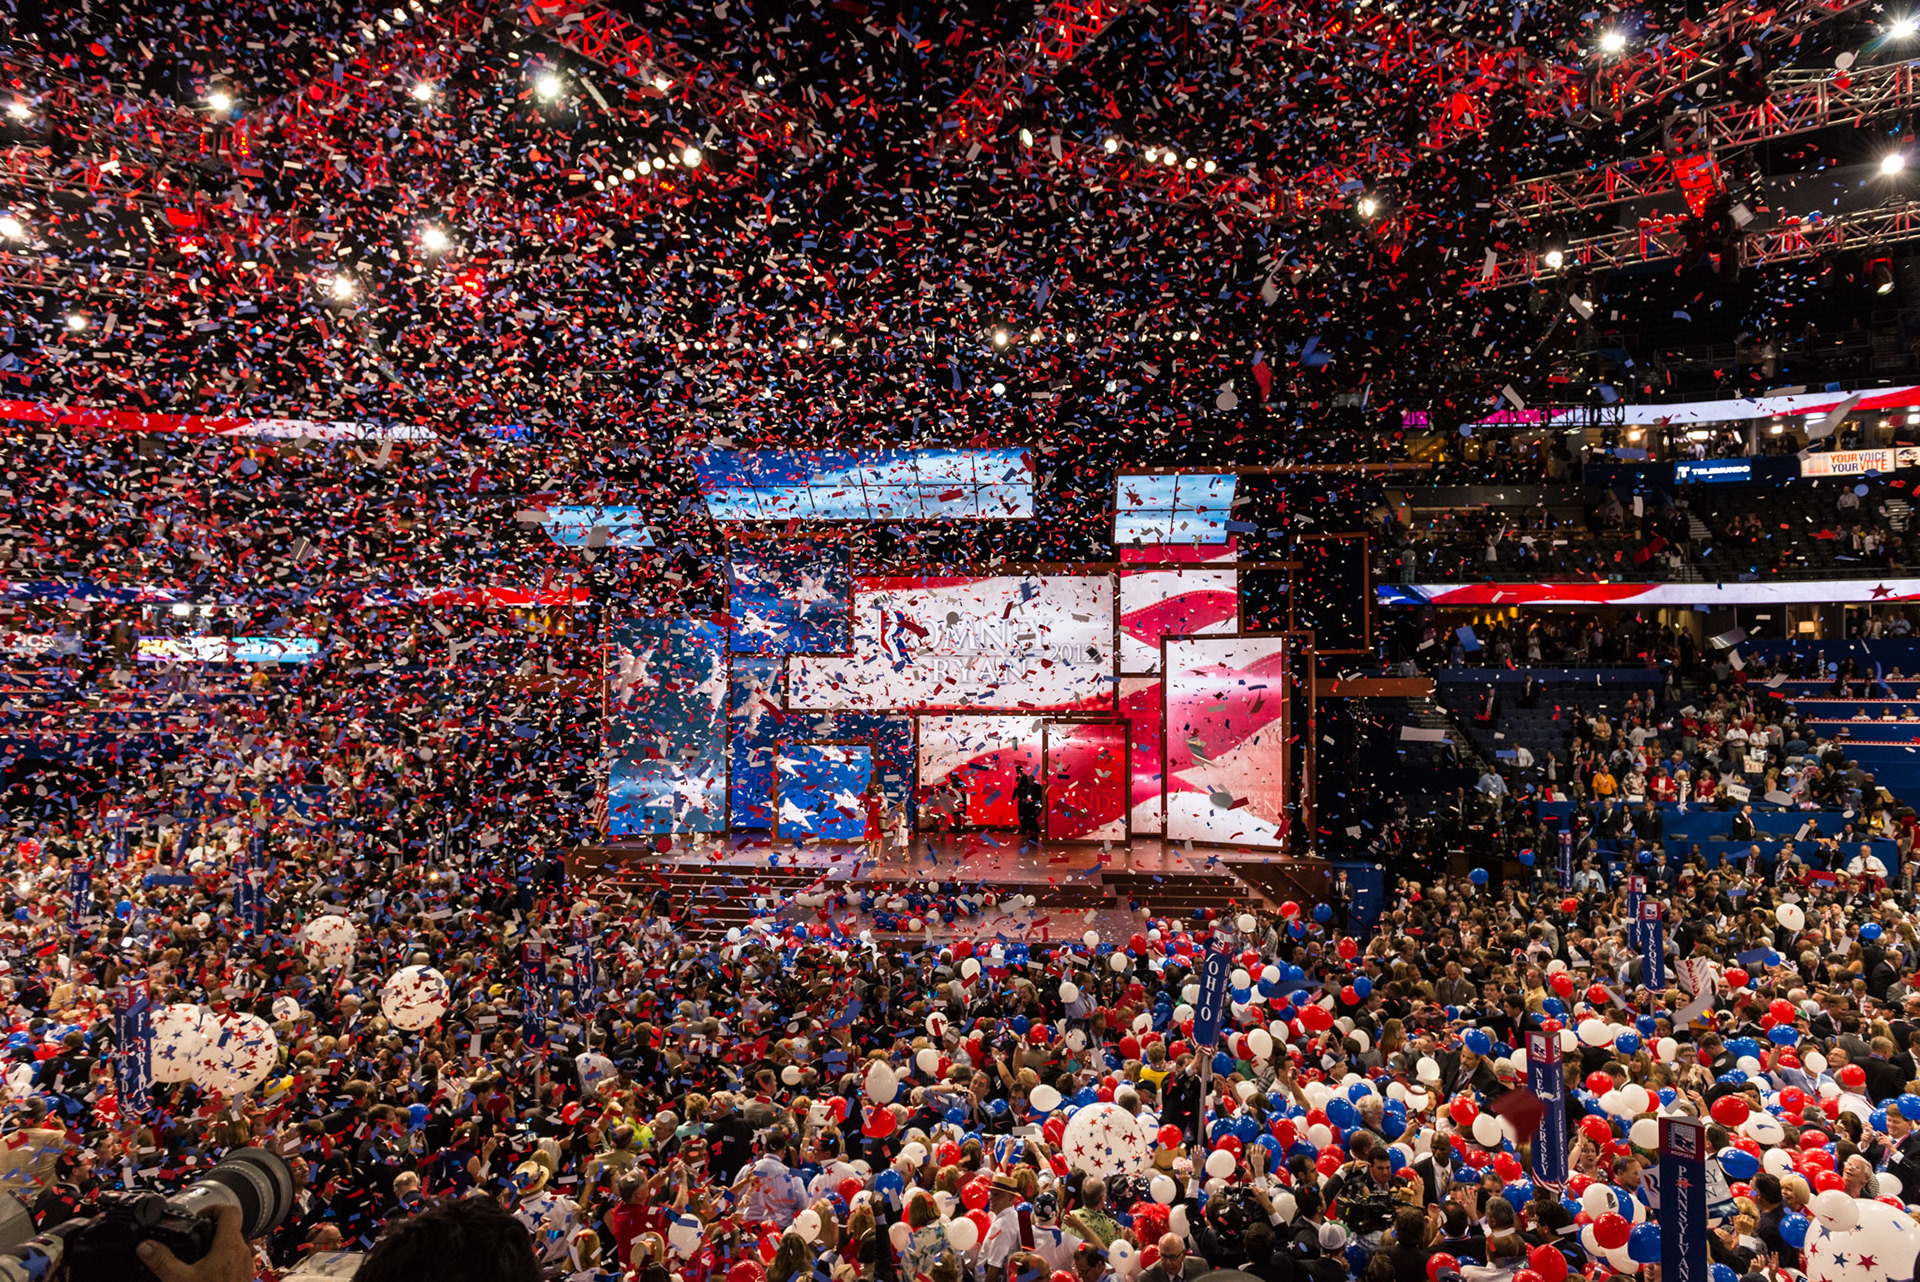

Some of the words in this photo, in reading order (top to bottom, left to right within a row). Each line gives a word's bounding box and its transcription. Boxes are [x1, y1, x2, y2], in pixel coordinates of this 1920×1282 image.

[1691, 465, 1751, 475] TELEMUNDO
[1830, 453, 1858, 463] YOUR
[1859, 451, 1887, 461] VOICE
[1831, 462, 1859, 472] YOUR
[1860, 458, 1887, 471] VOTE
[1050, 643, 1097, 663] 2012
[931, 659, 1028, 684] RYAN
[1635, 894, 1643, 942] VIRGINI
[1646, 922, 1658, 986] WISCONSIN
[1201, 961, 1219, 1021] OHIO
[1216, 963, 1230, 1023] OHIO
[121, 1014, 129, 1107] FLORDA
